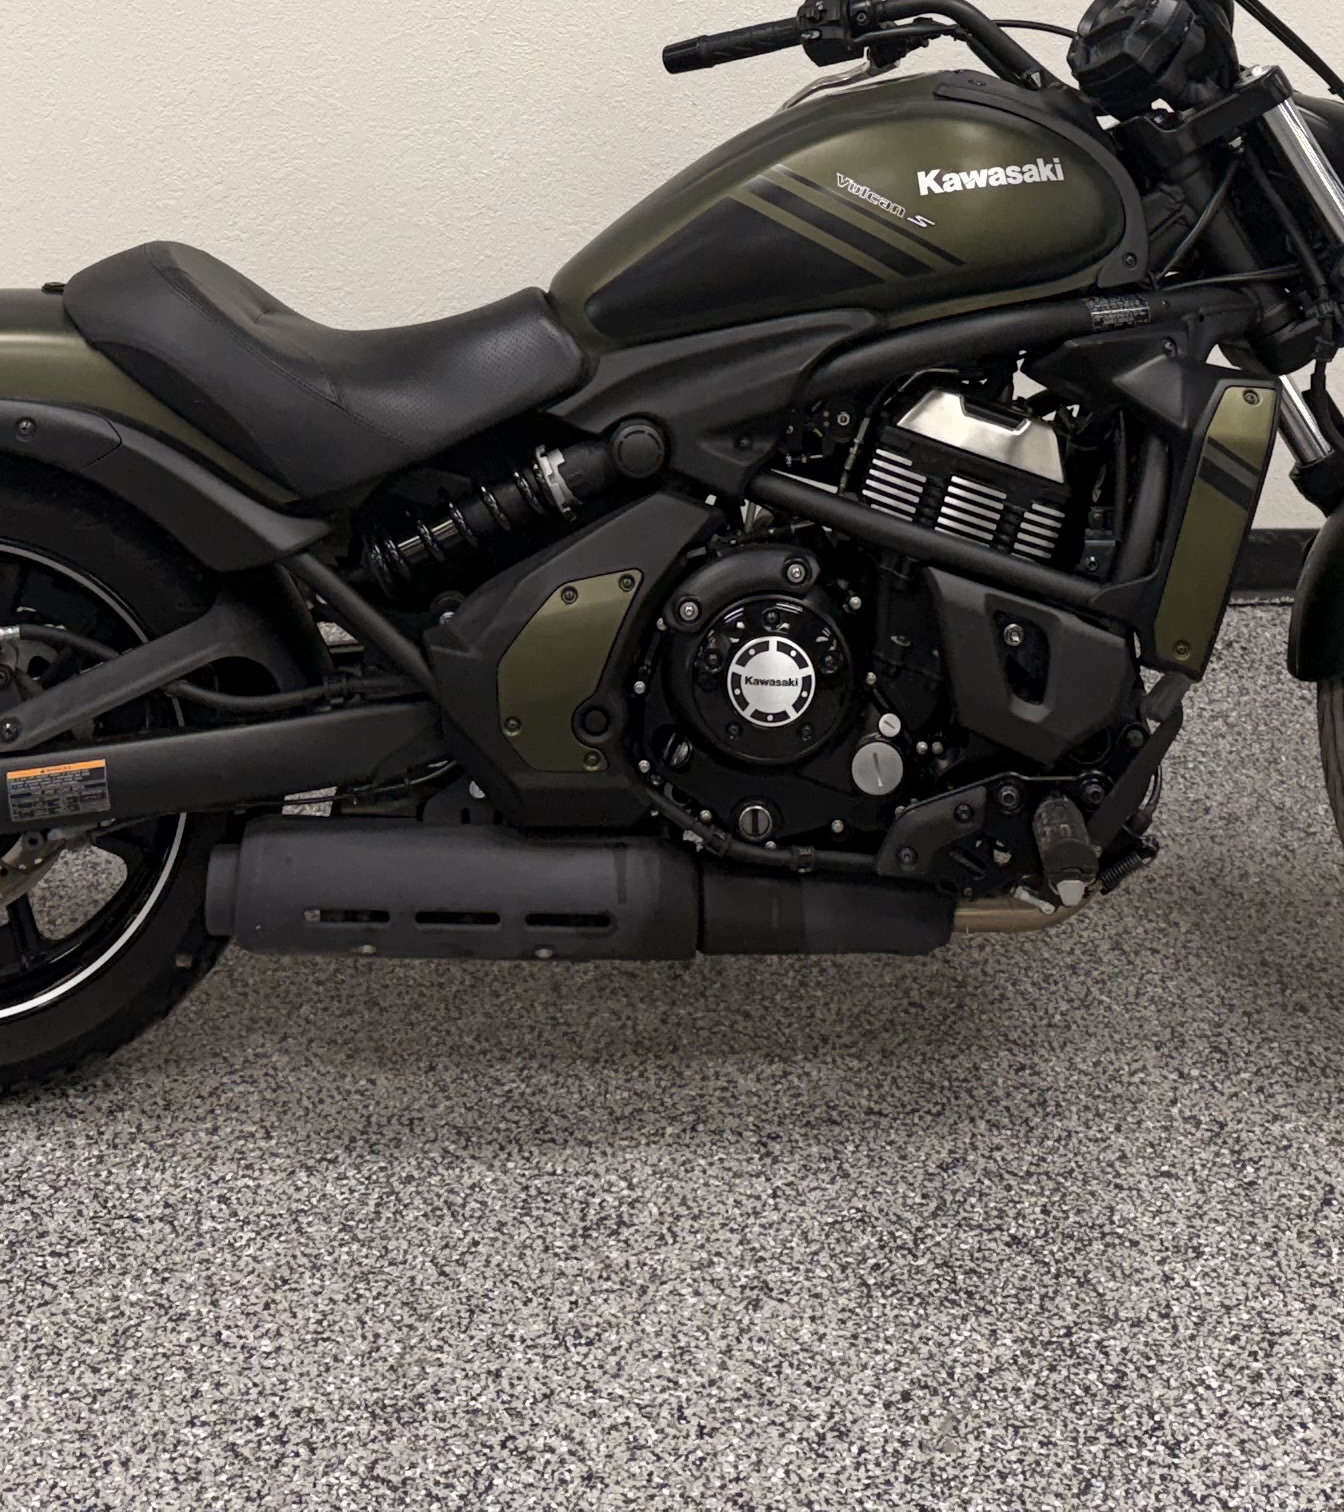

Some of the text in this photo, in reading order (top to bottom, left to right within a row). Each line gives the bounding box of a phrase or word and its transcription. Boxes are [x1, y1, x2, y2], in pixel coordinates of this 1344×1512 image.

[836, 172, 906, 219] Vulcan
[917, 157, 1065, 196] Kawasaki
[744, 675, 799, 687] Kawasaki
